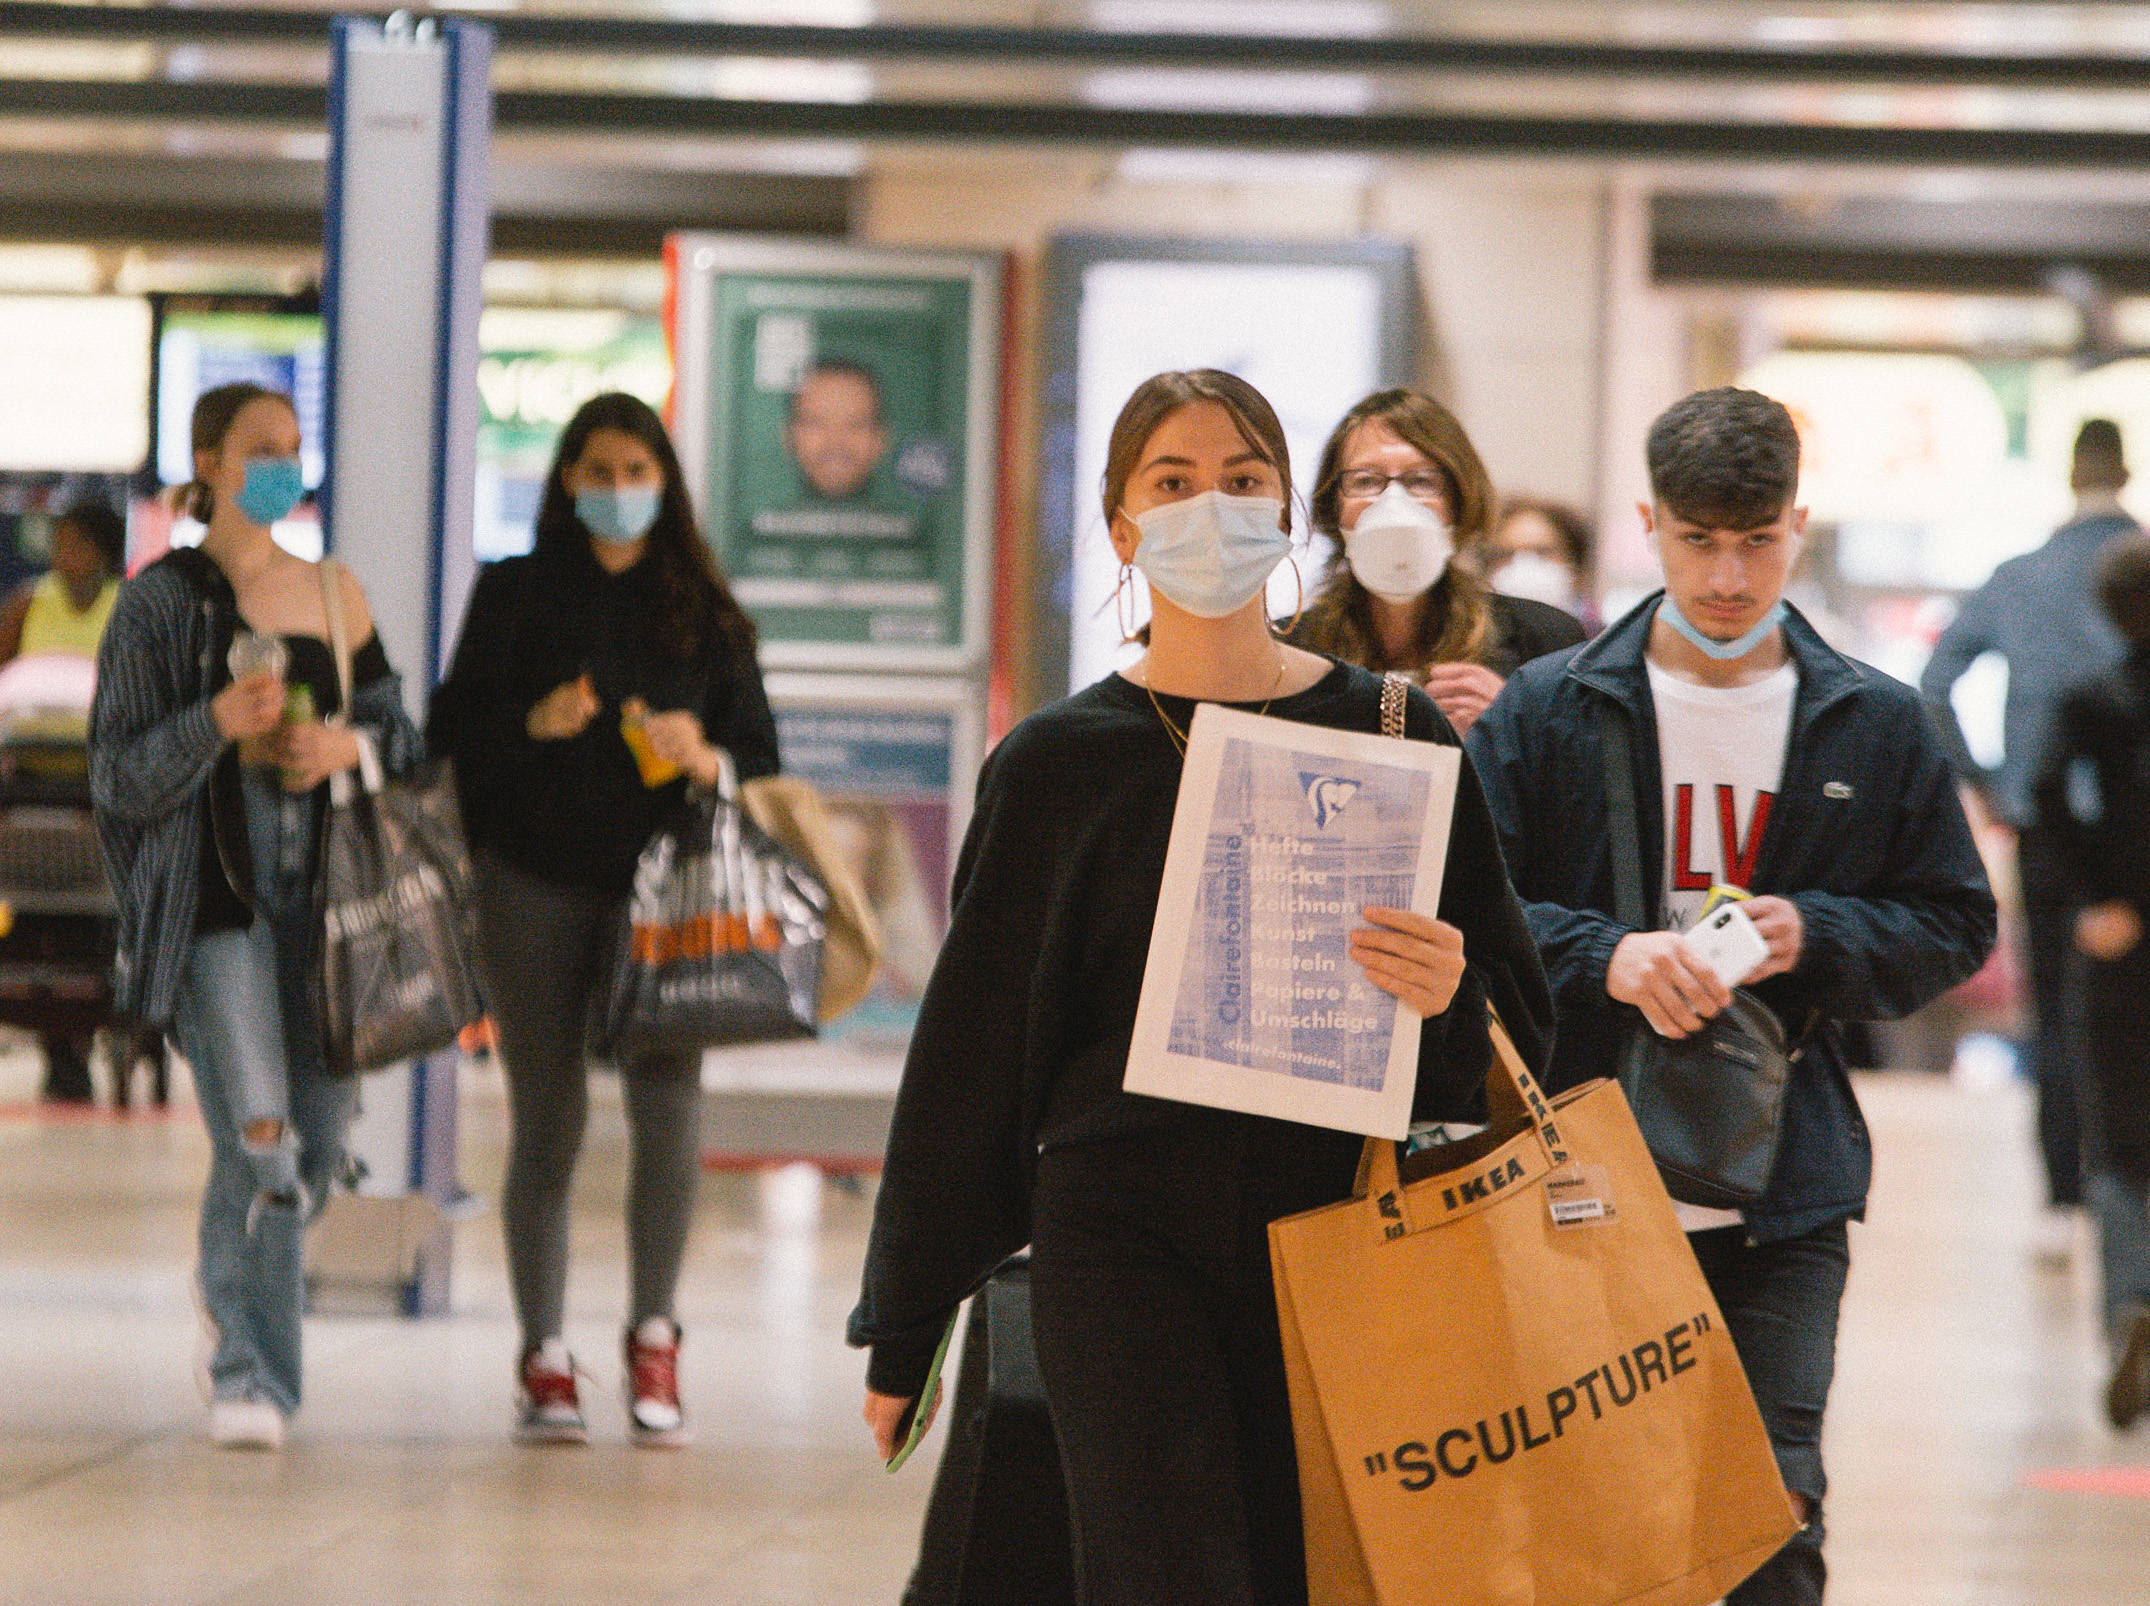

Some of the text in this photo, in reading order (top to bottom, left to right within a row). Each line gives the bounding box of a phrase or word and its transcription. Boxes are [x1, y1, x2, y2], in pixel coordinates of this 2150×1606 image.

[1250, 836, 1314, 855] Hefte
[1218, 834, 1242, 1025] Clairefontaine
[1250, 925, 1316, 943] Kunst
[1250, 979, 1341, 1004] Papiere
[1518, 1072, 1568, 1163] IKEA
[1441, 1157, 1525, 1211] IKEA
[1365, 1313, 1711, 1493] "SCULPTURE"
